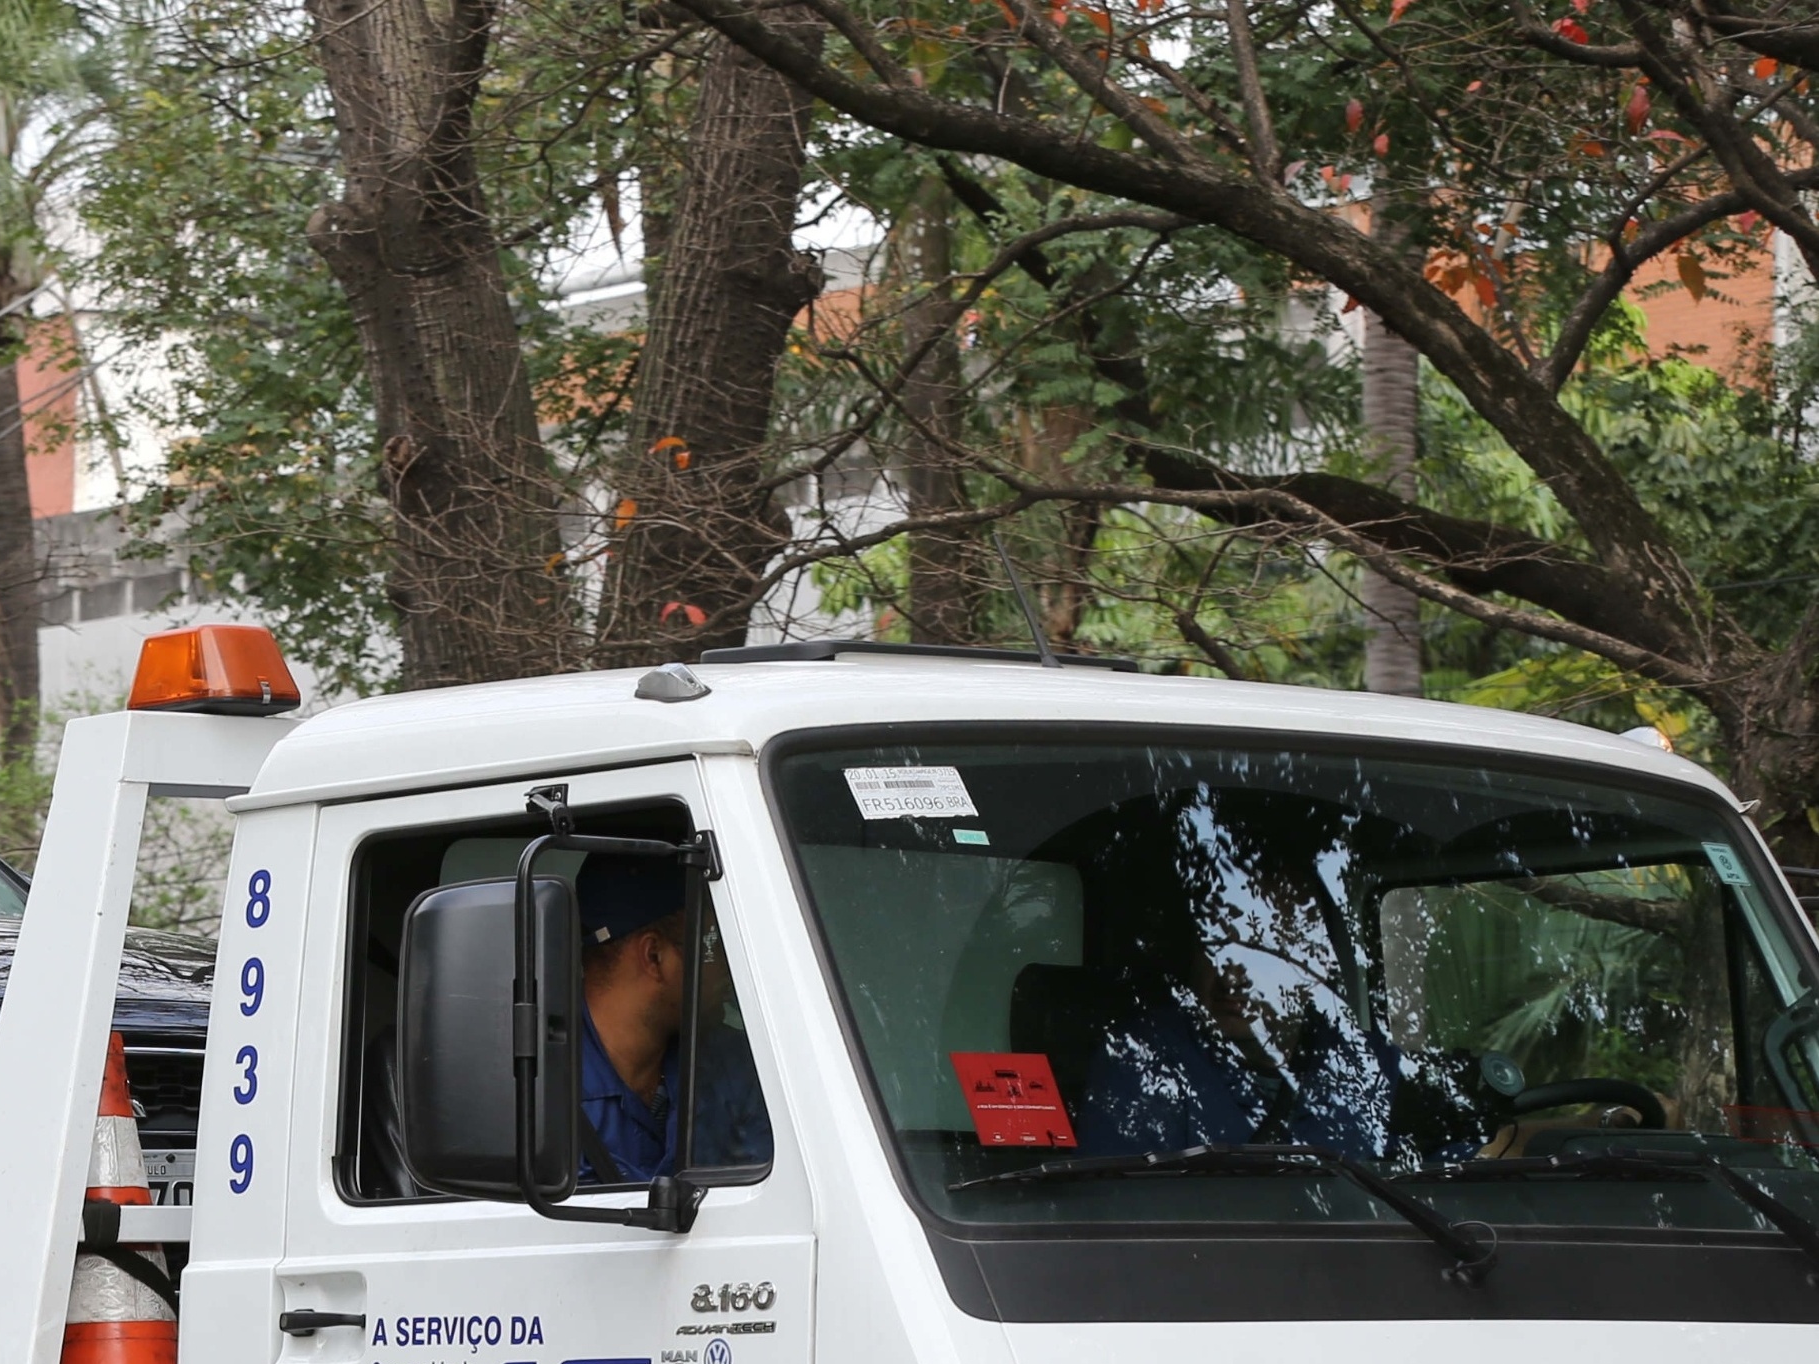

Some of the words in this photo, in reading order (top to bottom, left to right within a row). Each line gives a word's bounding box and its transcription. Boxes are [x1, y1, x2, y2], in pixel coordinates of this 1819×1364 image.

[372, 1317, 388, 1346] A
[396, 1316, 502, 1354] SERVIÇO
[510, 1316, 544, 1345] DA
[661, 1350, 698, 1363] MAN
